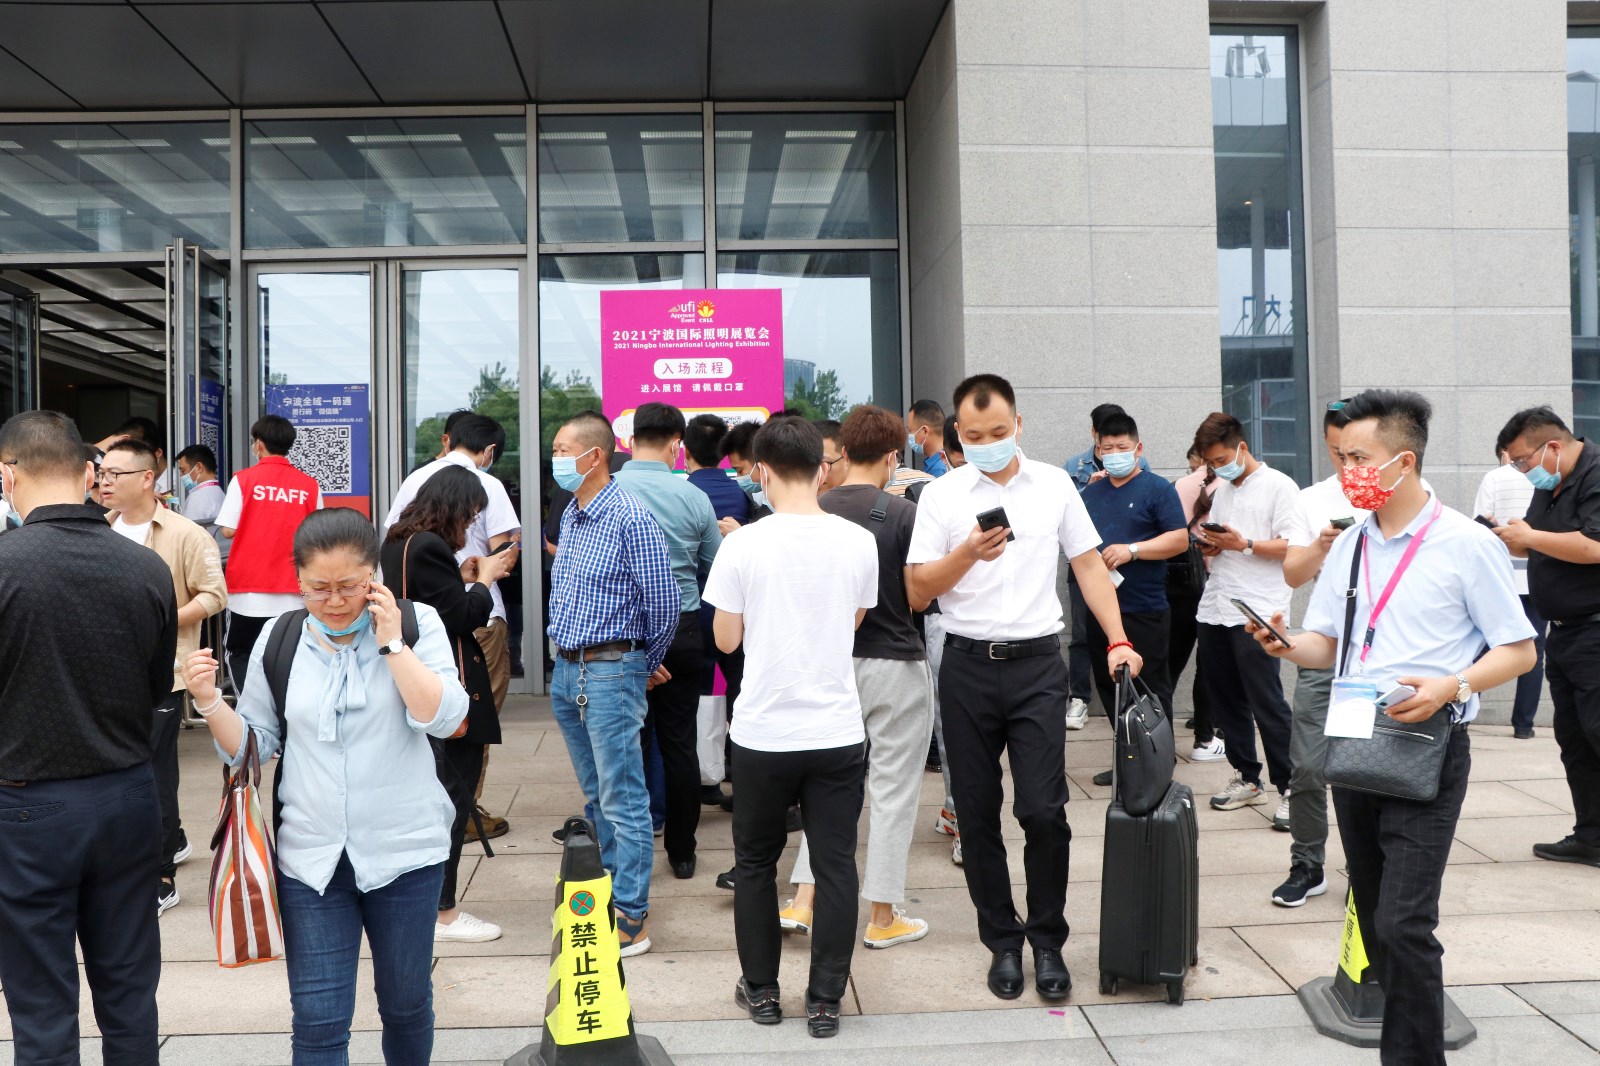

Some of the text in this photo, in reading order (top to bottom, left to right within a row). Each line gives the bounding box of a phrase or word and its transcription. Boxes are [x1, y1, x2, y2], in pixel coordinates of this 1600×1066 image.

[681, 301, 695, 313] ufi
[613, 327, 770, 341] 2021宁波国际照明展览会
[662, 362, 724, 375] 入场流程
[640, 382, 744, 393] 进入展馆 请佩戴口罩
[283, 396, 352, 407] 宁波全域一码通
[253, 485, 309, 505] STAFF
[571, 922, 602, 1034] 禁止停车
